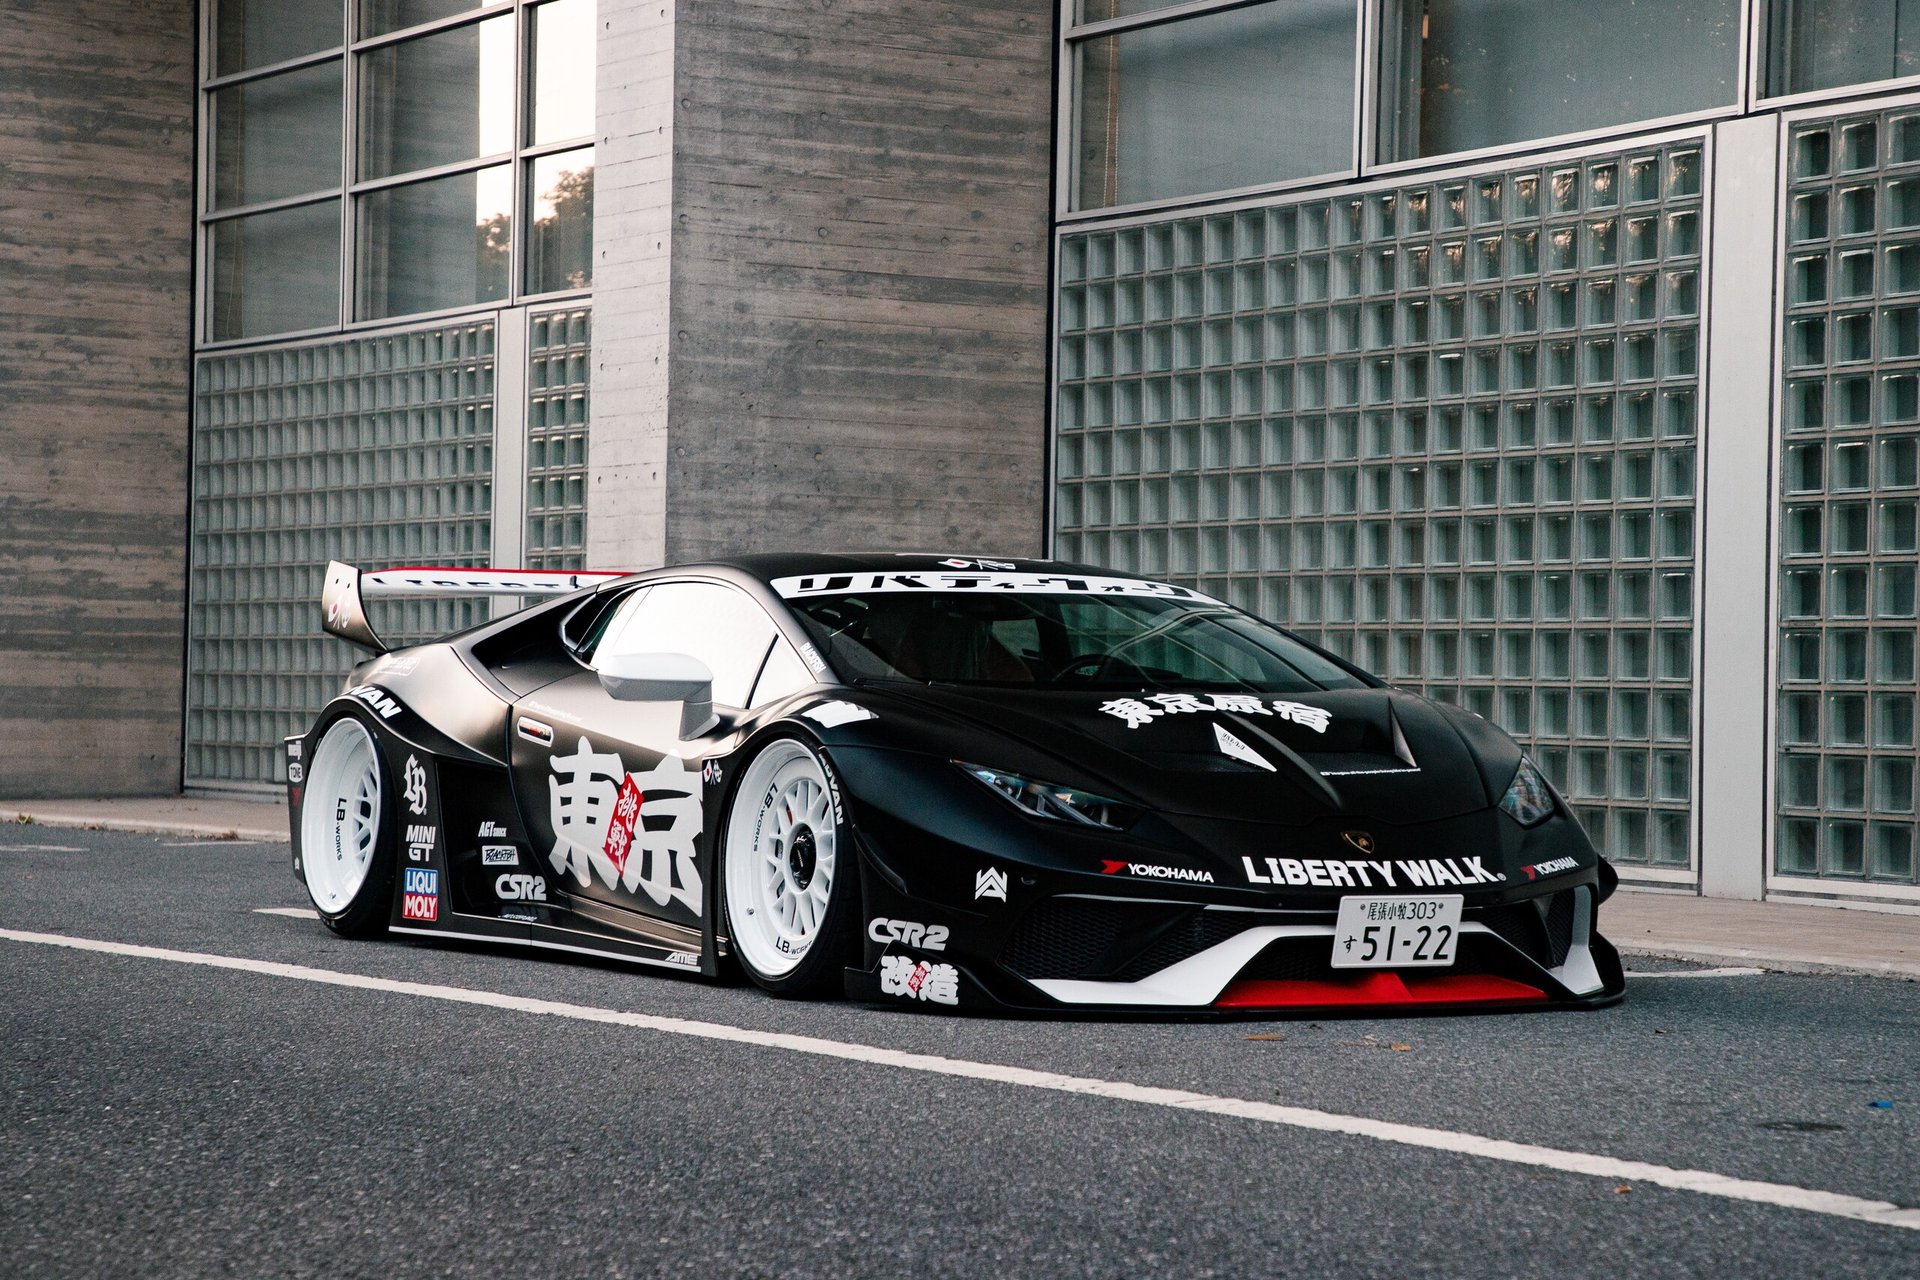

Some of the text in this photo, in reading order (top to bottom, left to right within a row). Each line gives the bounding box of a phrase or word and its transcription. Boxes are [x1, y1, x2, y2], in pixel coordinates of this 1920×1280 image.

[1098, 693, 1332, 733] 東京原宿
[405, 825, 436, 843] MINI
[548, 735, 703, 917] 東京
[408, 843, 434, 862] GT
[406, 870, 437, 894] LIQUI
[1127, 863, 1214, 883] YOKOHAMA
[1241, 856, 1397, 887] LIBERTY
[495, 873, 547, 901] CSR2
[404, 895, 437, 918] MOLY
[868, 917, 950, 951] CSR2
[1360, 925, 1452, 961] 51-22
[665, 951, 698, 965] AME
